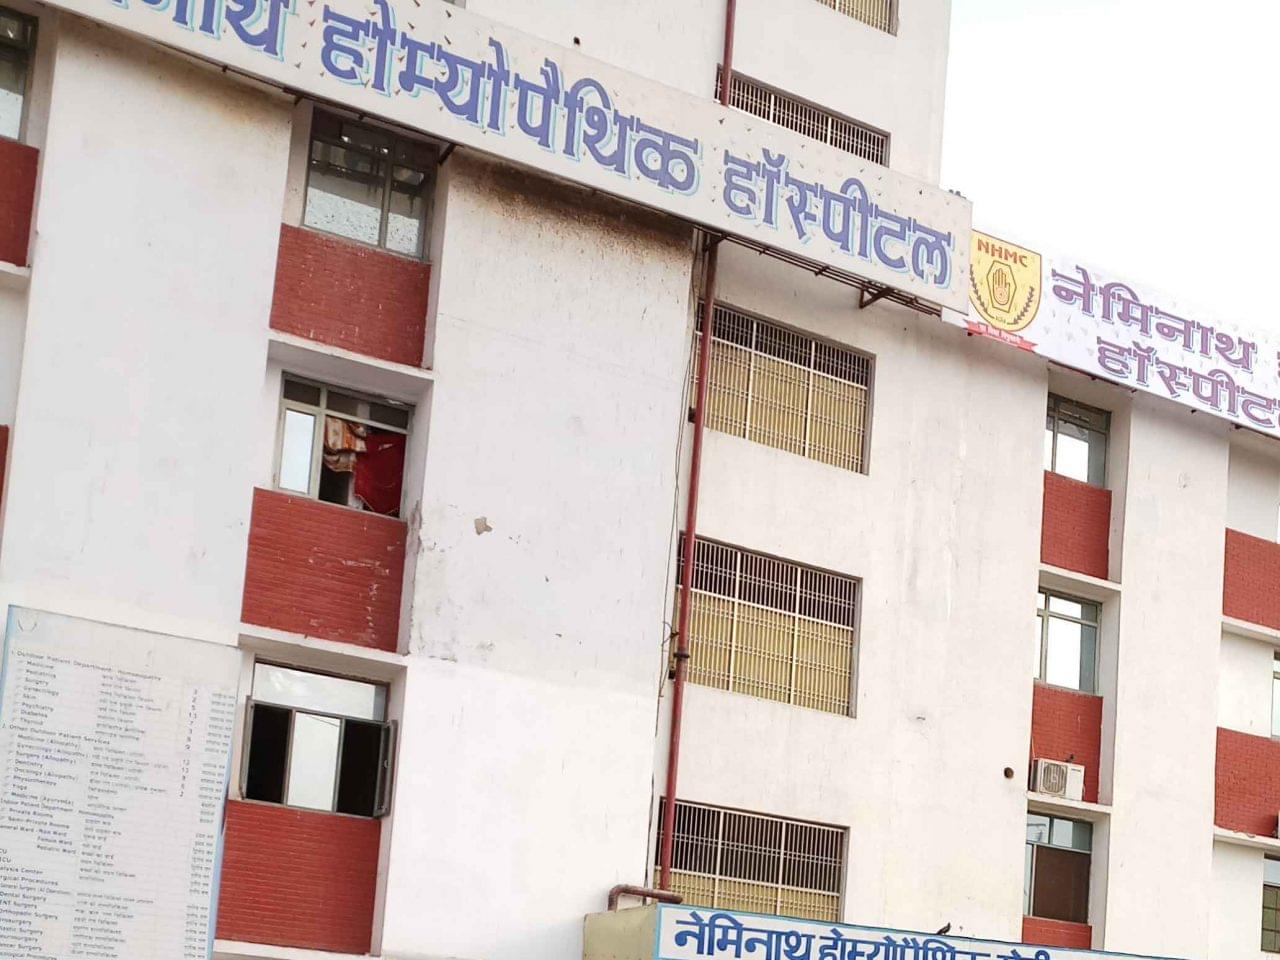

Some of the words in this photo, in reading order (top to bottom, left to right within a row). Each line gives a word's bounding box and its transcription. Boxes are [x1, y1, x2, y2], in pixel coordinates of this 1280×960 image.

[321, 0, 704, 196] होम्योपैथिक
[723, 148, 956, 289] हॉस्पीटल
[977, 238, 1028, 268] NHMC
[1051, 265, 1257, 373] नेमिनाथ
